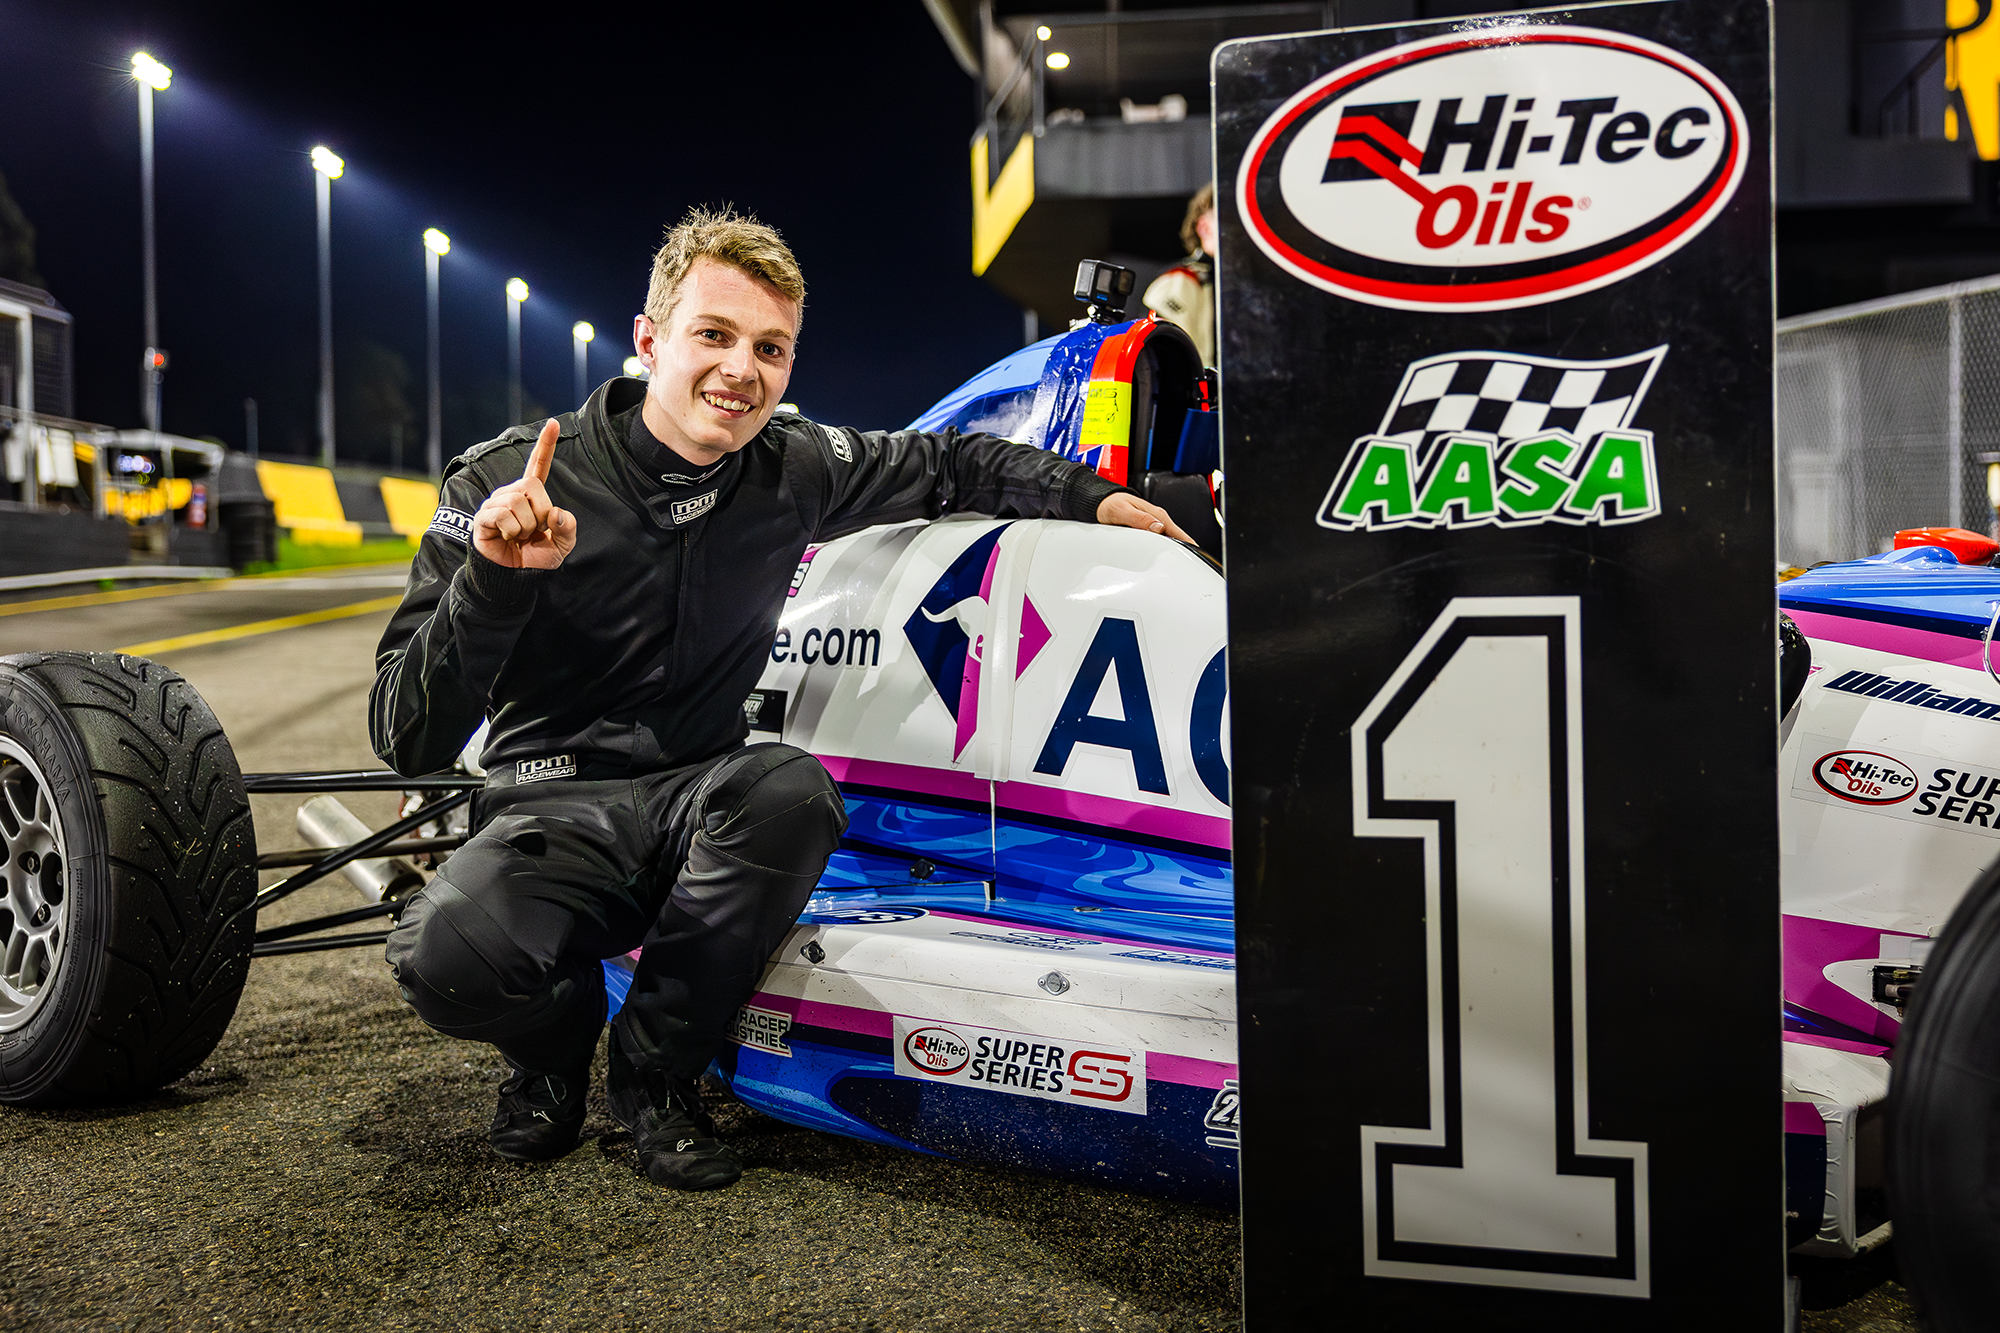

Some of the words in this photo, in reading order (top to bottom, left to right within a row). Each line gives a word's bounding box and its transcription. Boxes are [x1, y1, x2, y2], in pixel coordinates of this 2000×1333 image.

[1418, 94, 1710, 175] Hi-Tec
[1415, 180, 1574, 249] Oils
[1316, 428, 1662, 532] AASA
[676, 492, 715, 514] rpm
[12, 703, 71, 806] YOKOHAMA
[521, 754, 571, 775] rpm
[518, 767, 574, 782] RACEWEAR
[1847, 778, 1883, 797] Oils
[1852, 761, 1914, 788] Hi-Tec
[1351, 596, 1650, 1298] 1
[740, 1009, 789, 1032] RACER
[926, 1052, 949, 1067] Oils
[927, 1036, 967, 1057] Hi-Tec
[975, 1036, 1065, 1070] SUPER
[969, 1059, 1065, 1093] SERIES
